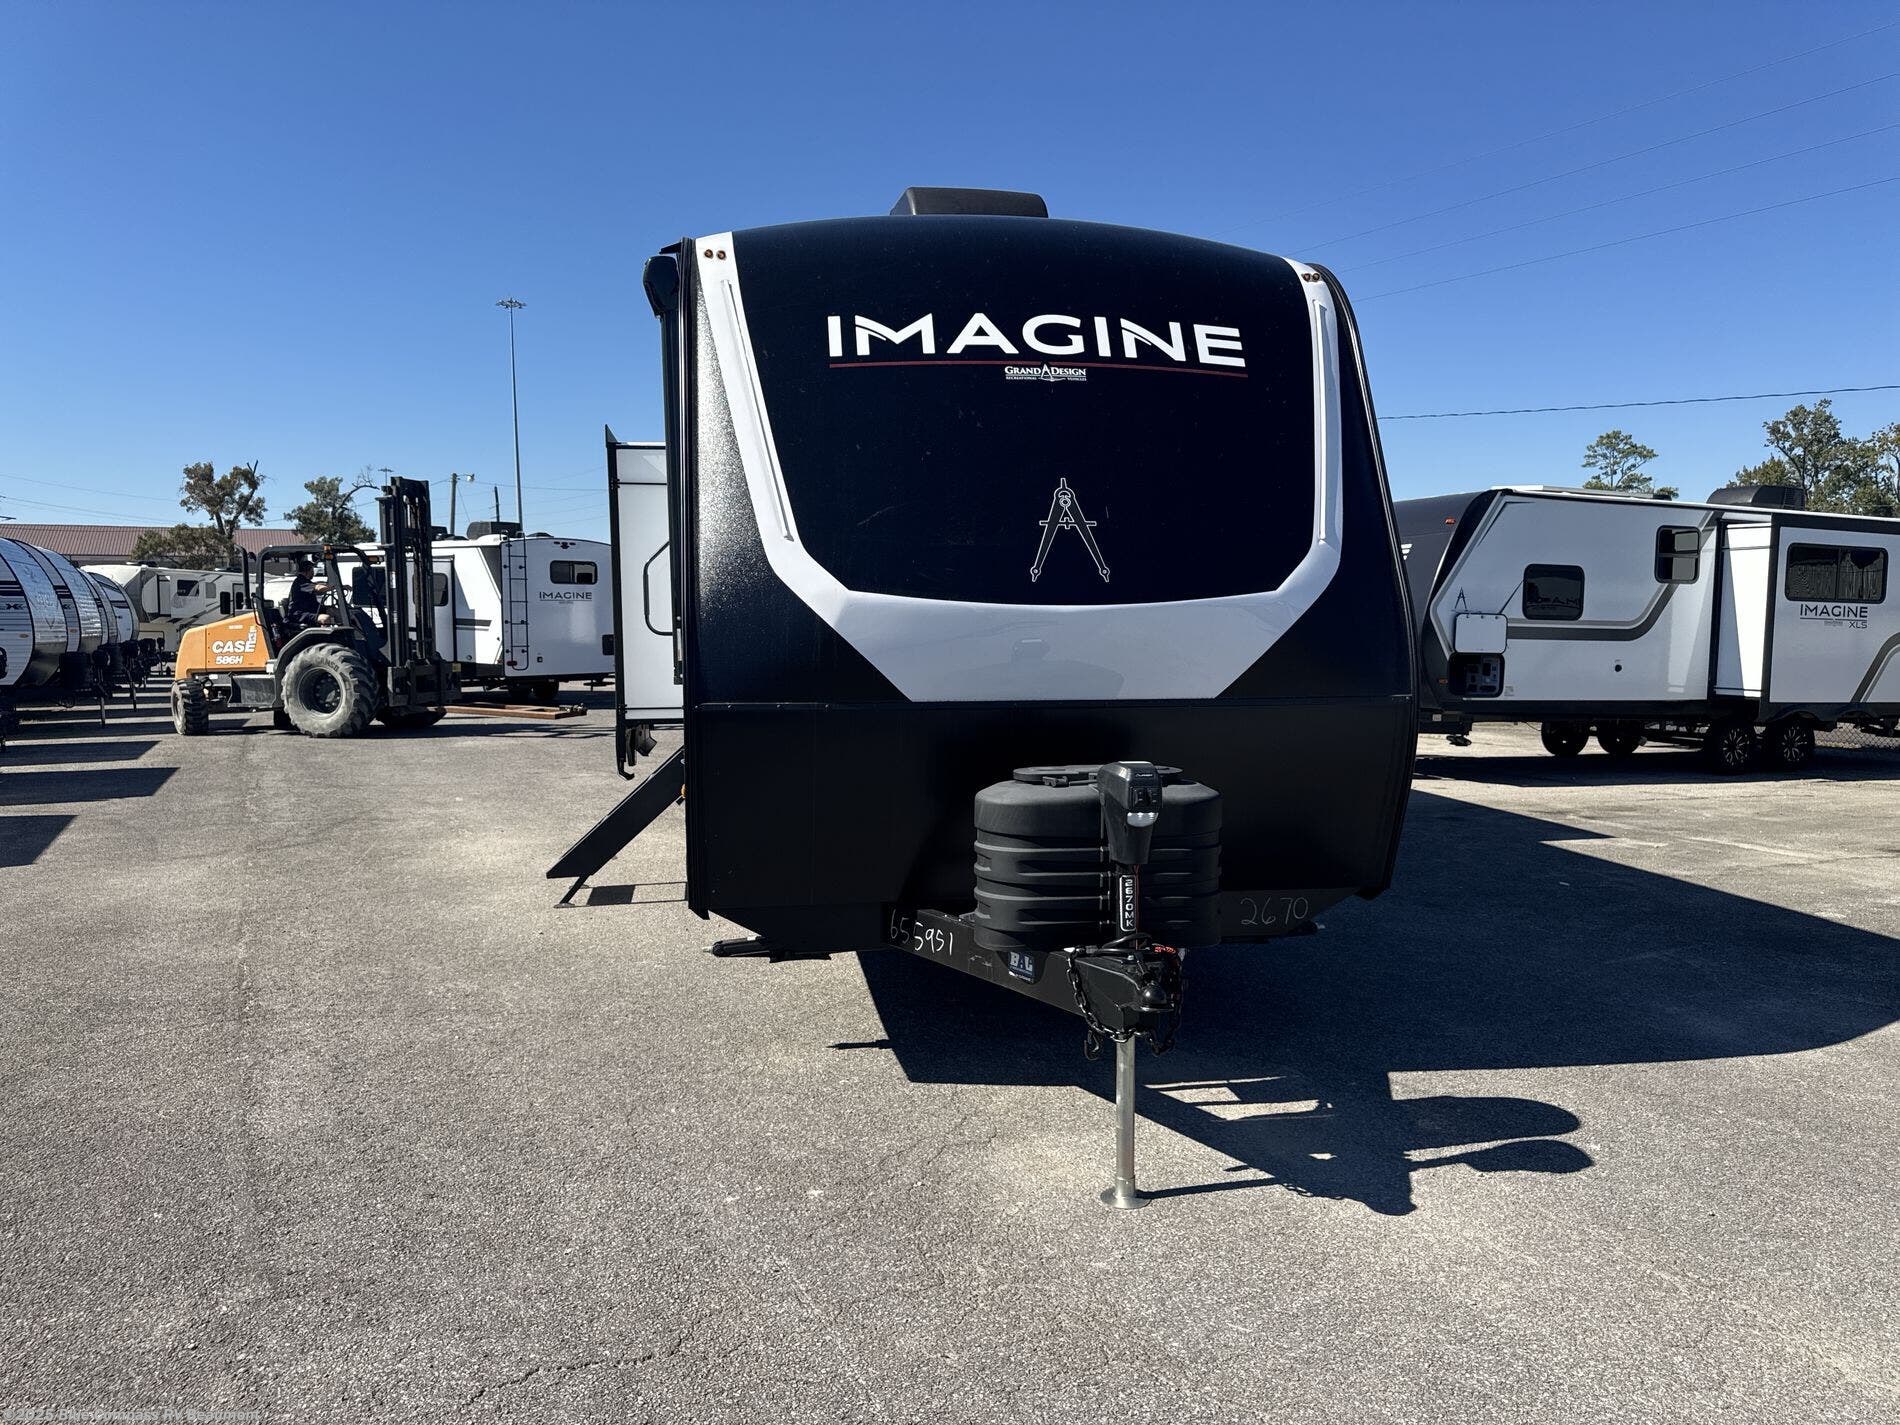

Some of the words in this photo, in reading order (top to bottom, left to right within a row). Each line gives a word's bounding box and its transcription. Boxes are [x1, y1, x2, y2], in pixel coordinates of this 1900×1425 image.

[827, 312, 1246, 367] IMAGINE
[1004, 366, 1041, 375] GRAND
[1050, 367, 1087, 376] DESIGN
[539, 591, 593, 600] IMAGINE
[1800, 603, 1868, 618] IMAGINE
[1848, 621, 1868, 629] XLS
[212, 640, 257, 654] CASE
[1124, 879, 1135, 928] 2670MK
[1240, 897, 1309, 925] 2670
[890, 909, 954, 956] 655951
